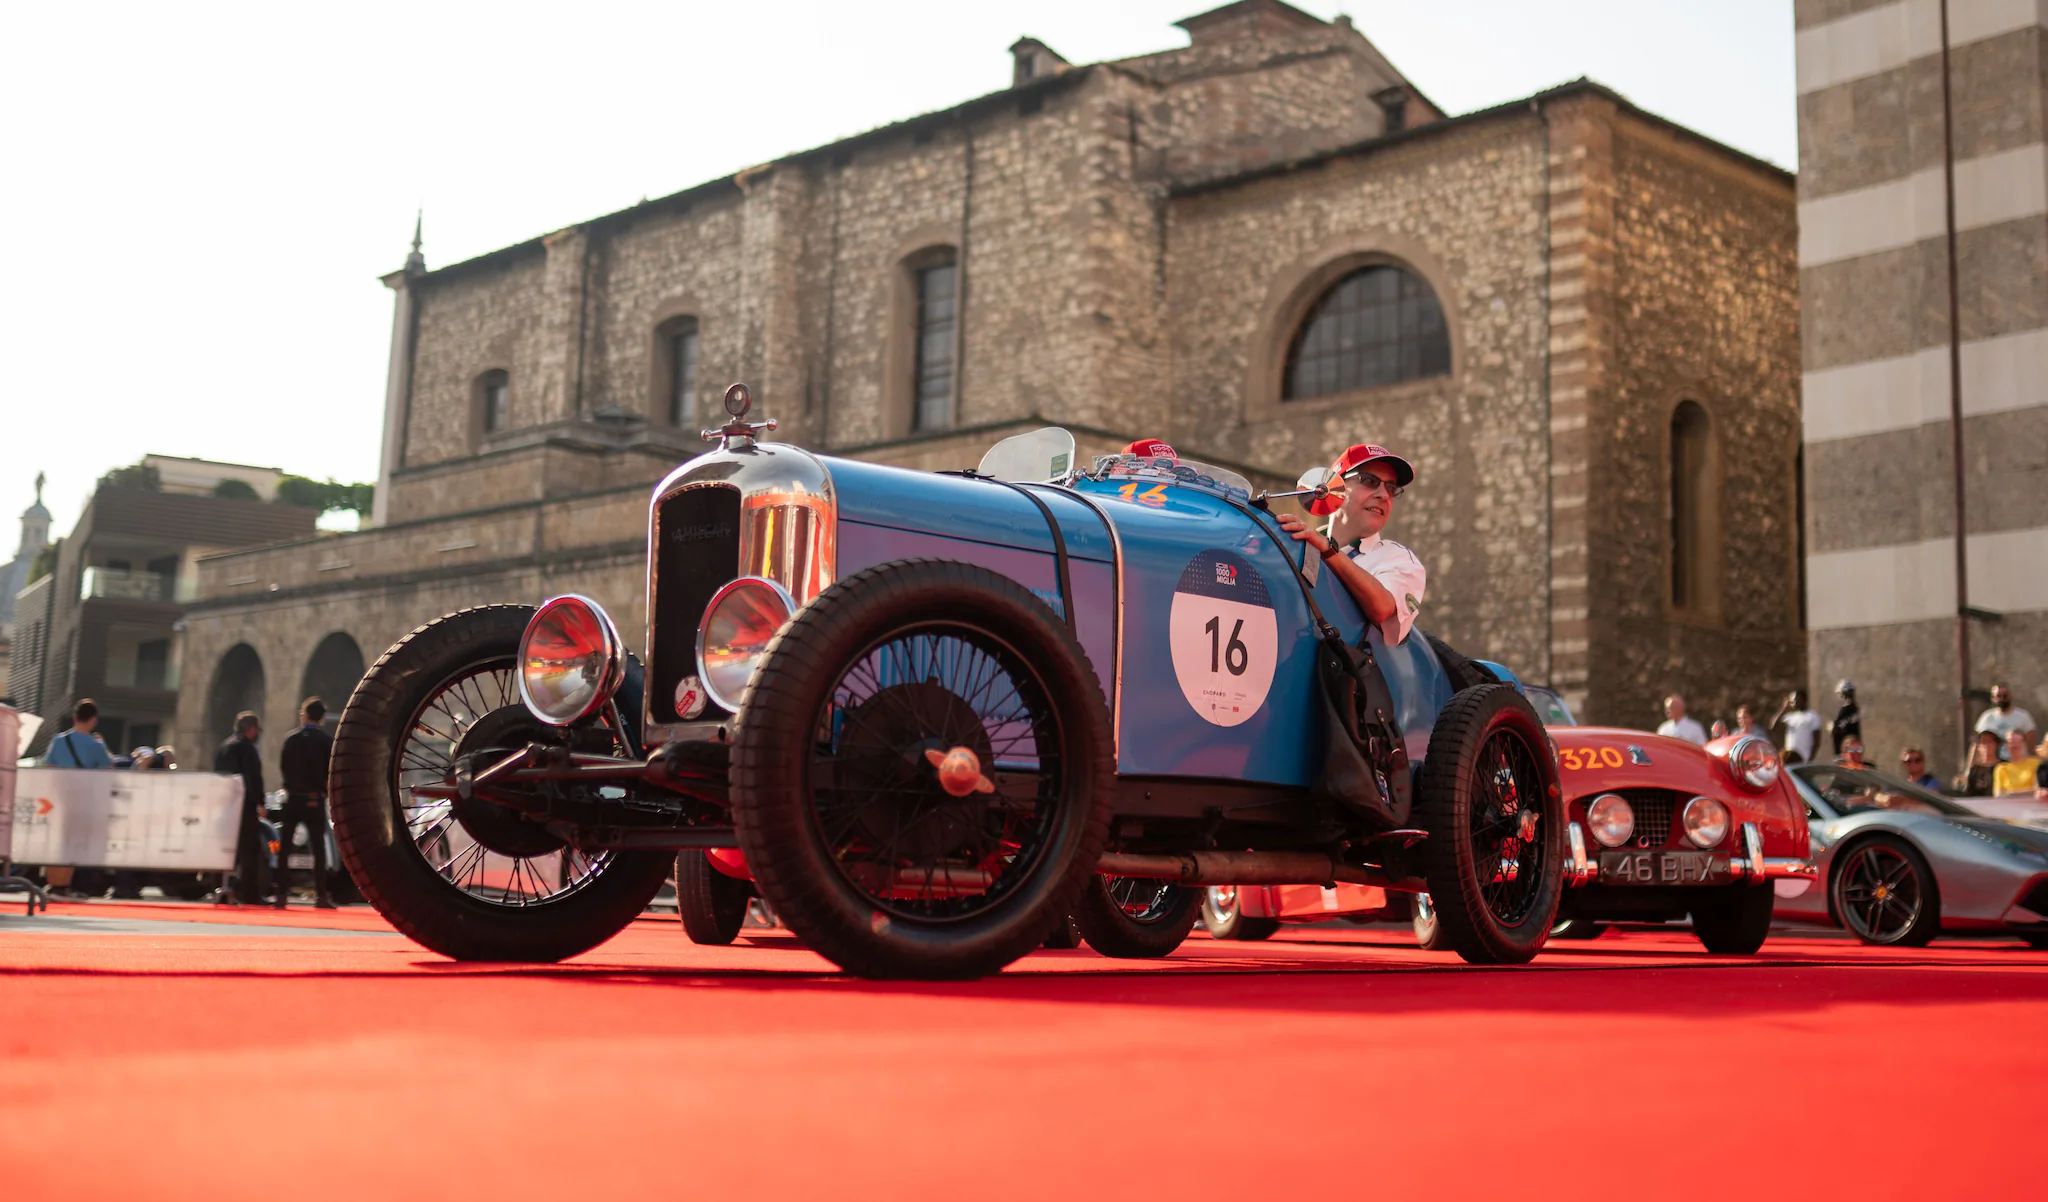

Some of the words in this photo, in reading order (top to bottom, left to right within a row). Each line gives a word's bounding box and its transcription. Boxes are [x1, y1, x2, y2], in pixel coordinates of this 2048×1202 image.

[1118, 482, 1168, 502] 16
[1216, 567, 1230, 577] 1000
[1216, 575, 1236, 586] MIGLIA
[1205, 616, 1248, 676] 16
[1559, 746, 1624, 770] 320
[1617, 856, 1652, 881] 46
[1661, 856, 1714, 882] BHX
